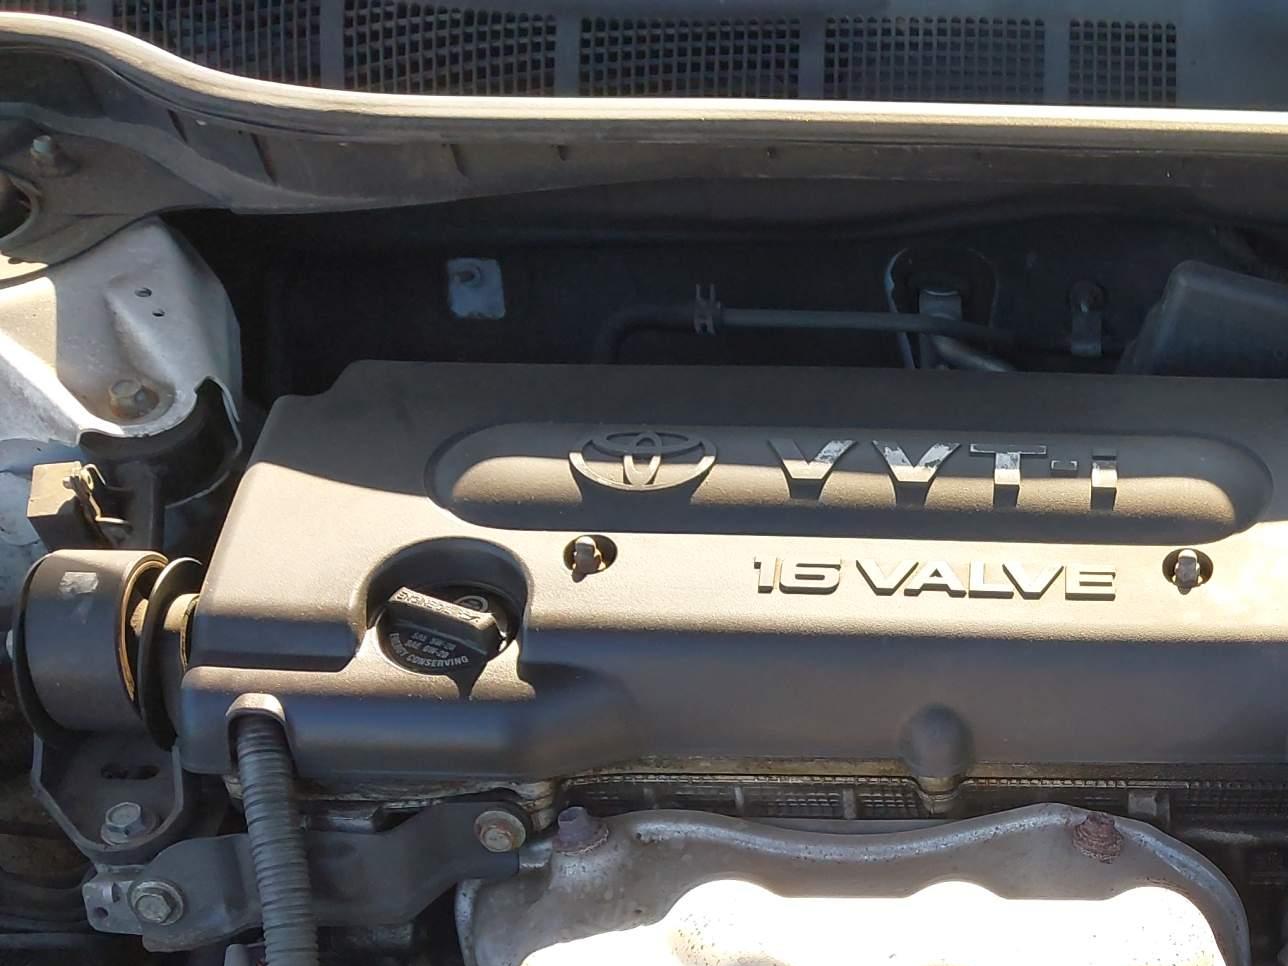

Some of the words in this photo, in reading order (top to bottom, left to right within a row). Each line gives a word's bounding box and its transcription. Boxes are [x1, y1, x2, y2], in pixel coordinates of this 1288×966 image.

[753, 556, 843, 594] 16
[856, 557, 1118, 602] VALVE
[406, 655, 470, 668] CONSERVING
